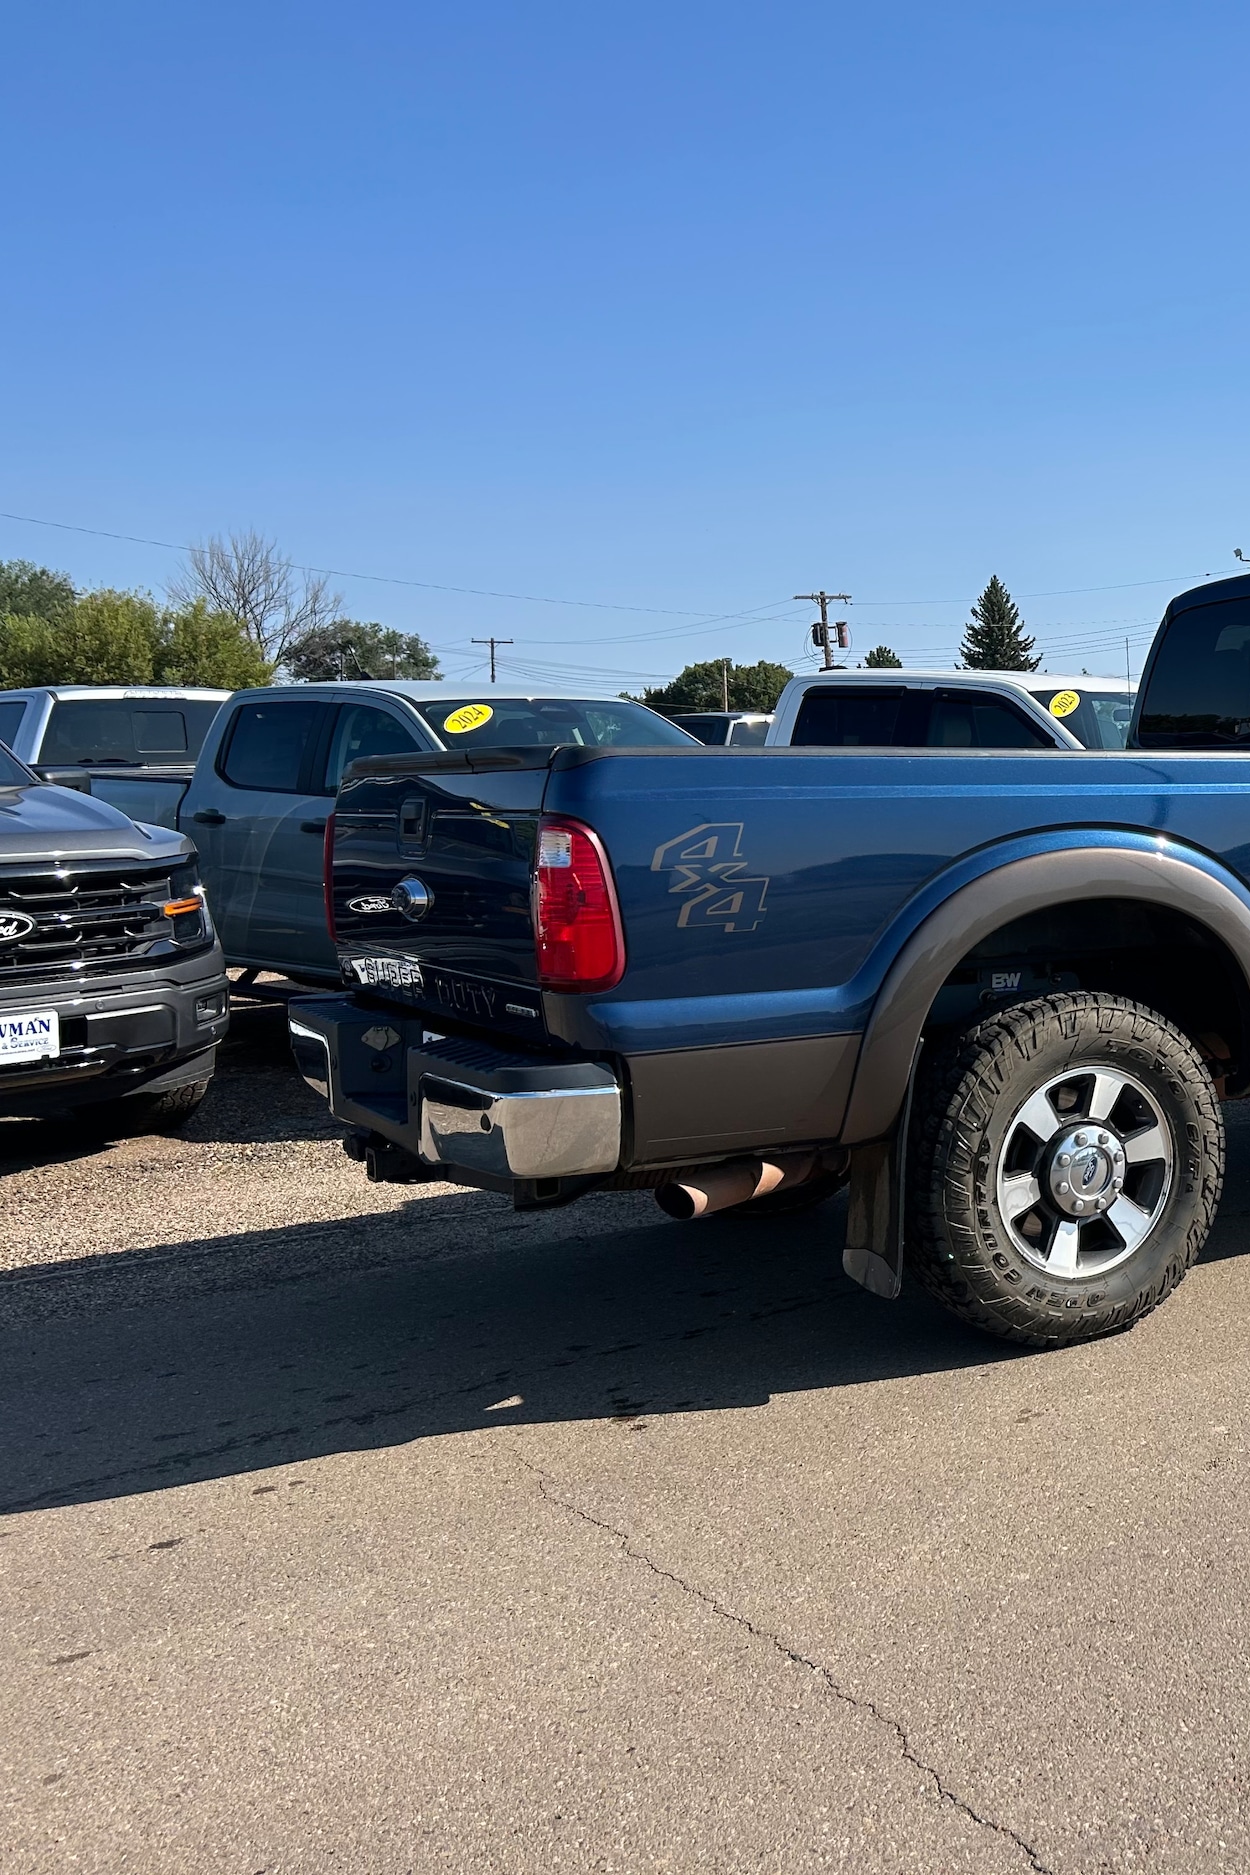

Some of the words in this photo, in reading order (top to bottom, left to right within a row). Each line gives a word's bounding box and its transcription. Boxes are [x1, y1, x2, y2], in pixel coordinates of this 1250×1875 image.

[451, 706, 485, 729] 2024
[1053, 693, 1076, 713] 2023
[364, 956, 426, 1000] SUPER
[434, 976, 496, 1018] DUTY
[1105, 1038, 1188, 1102] TOYO
[975, 1133, 1024, 1287] COUNTRY
[1025, 1283, 1107, 1309] OPEN
